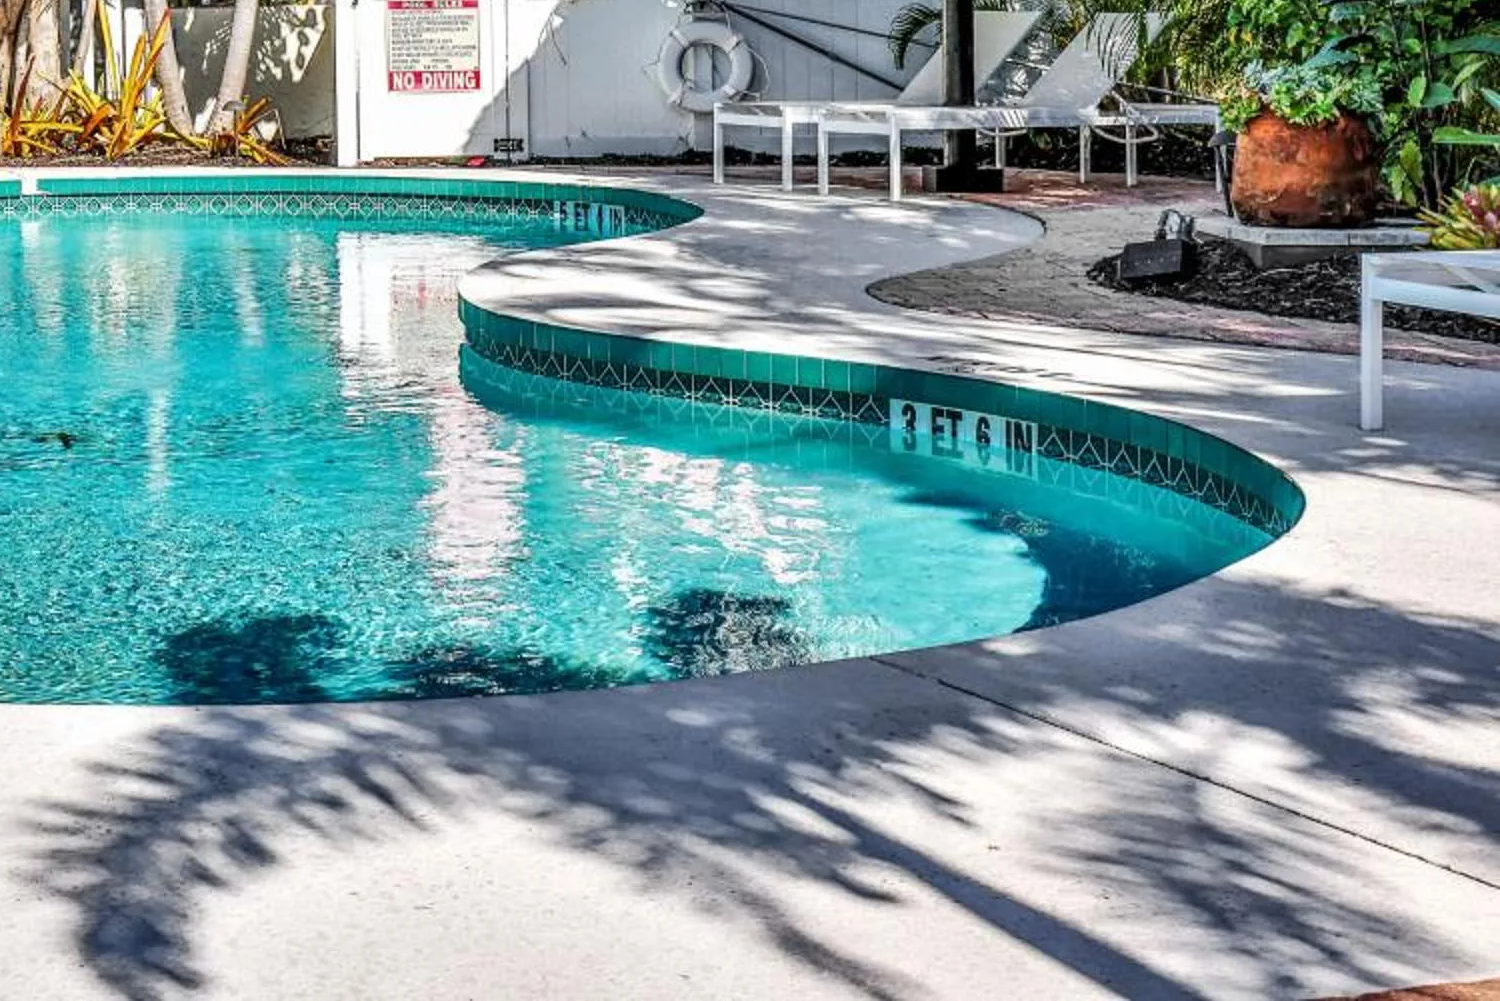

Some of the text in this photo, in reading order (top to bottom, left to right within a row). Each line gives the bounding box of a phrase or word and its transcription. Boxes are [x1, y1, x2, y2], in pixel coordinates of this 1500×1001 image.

[393, 70, 476, 90] NO DIVING
[901, 403, 1033, 454] 3 FT 6 IN
